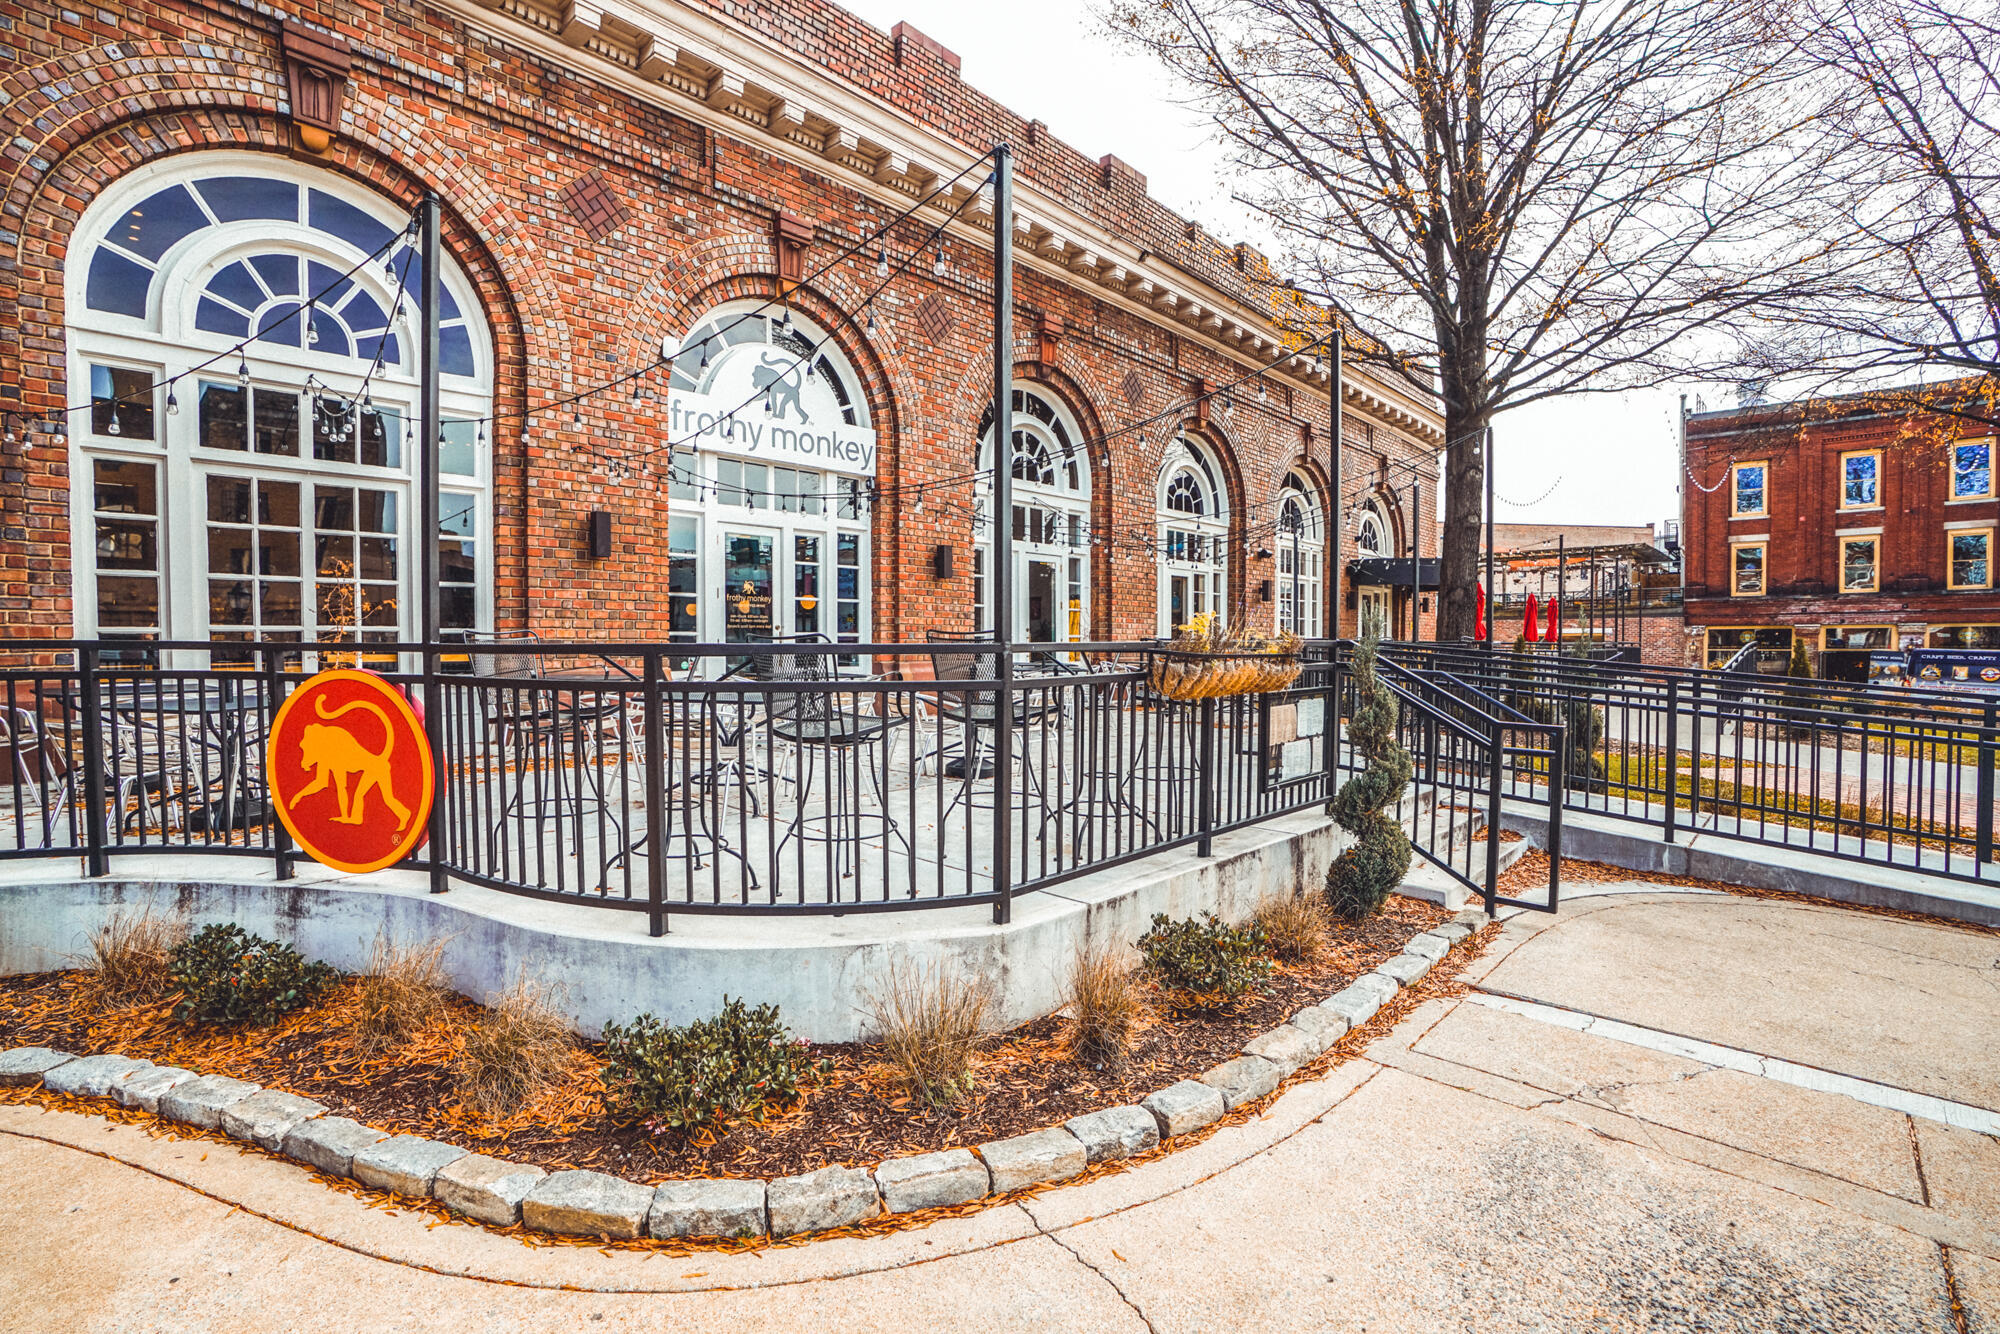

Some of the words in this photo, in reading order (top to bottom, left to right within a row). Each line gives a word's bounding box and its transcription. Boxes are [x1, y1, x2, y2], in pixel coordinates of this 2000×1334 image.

[671, 399, 763, 451] frothy
[772, 426, 873, 471] monkey
[726, 593, 746, 602] frothy
[747, 595, 772, 604] monkey
